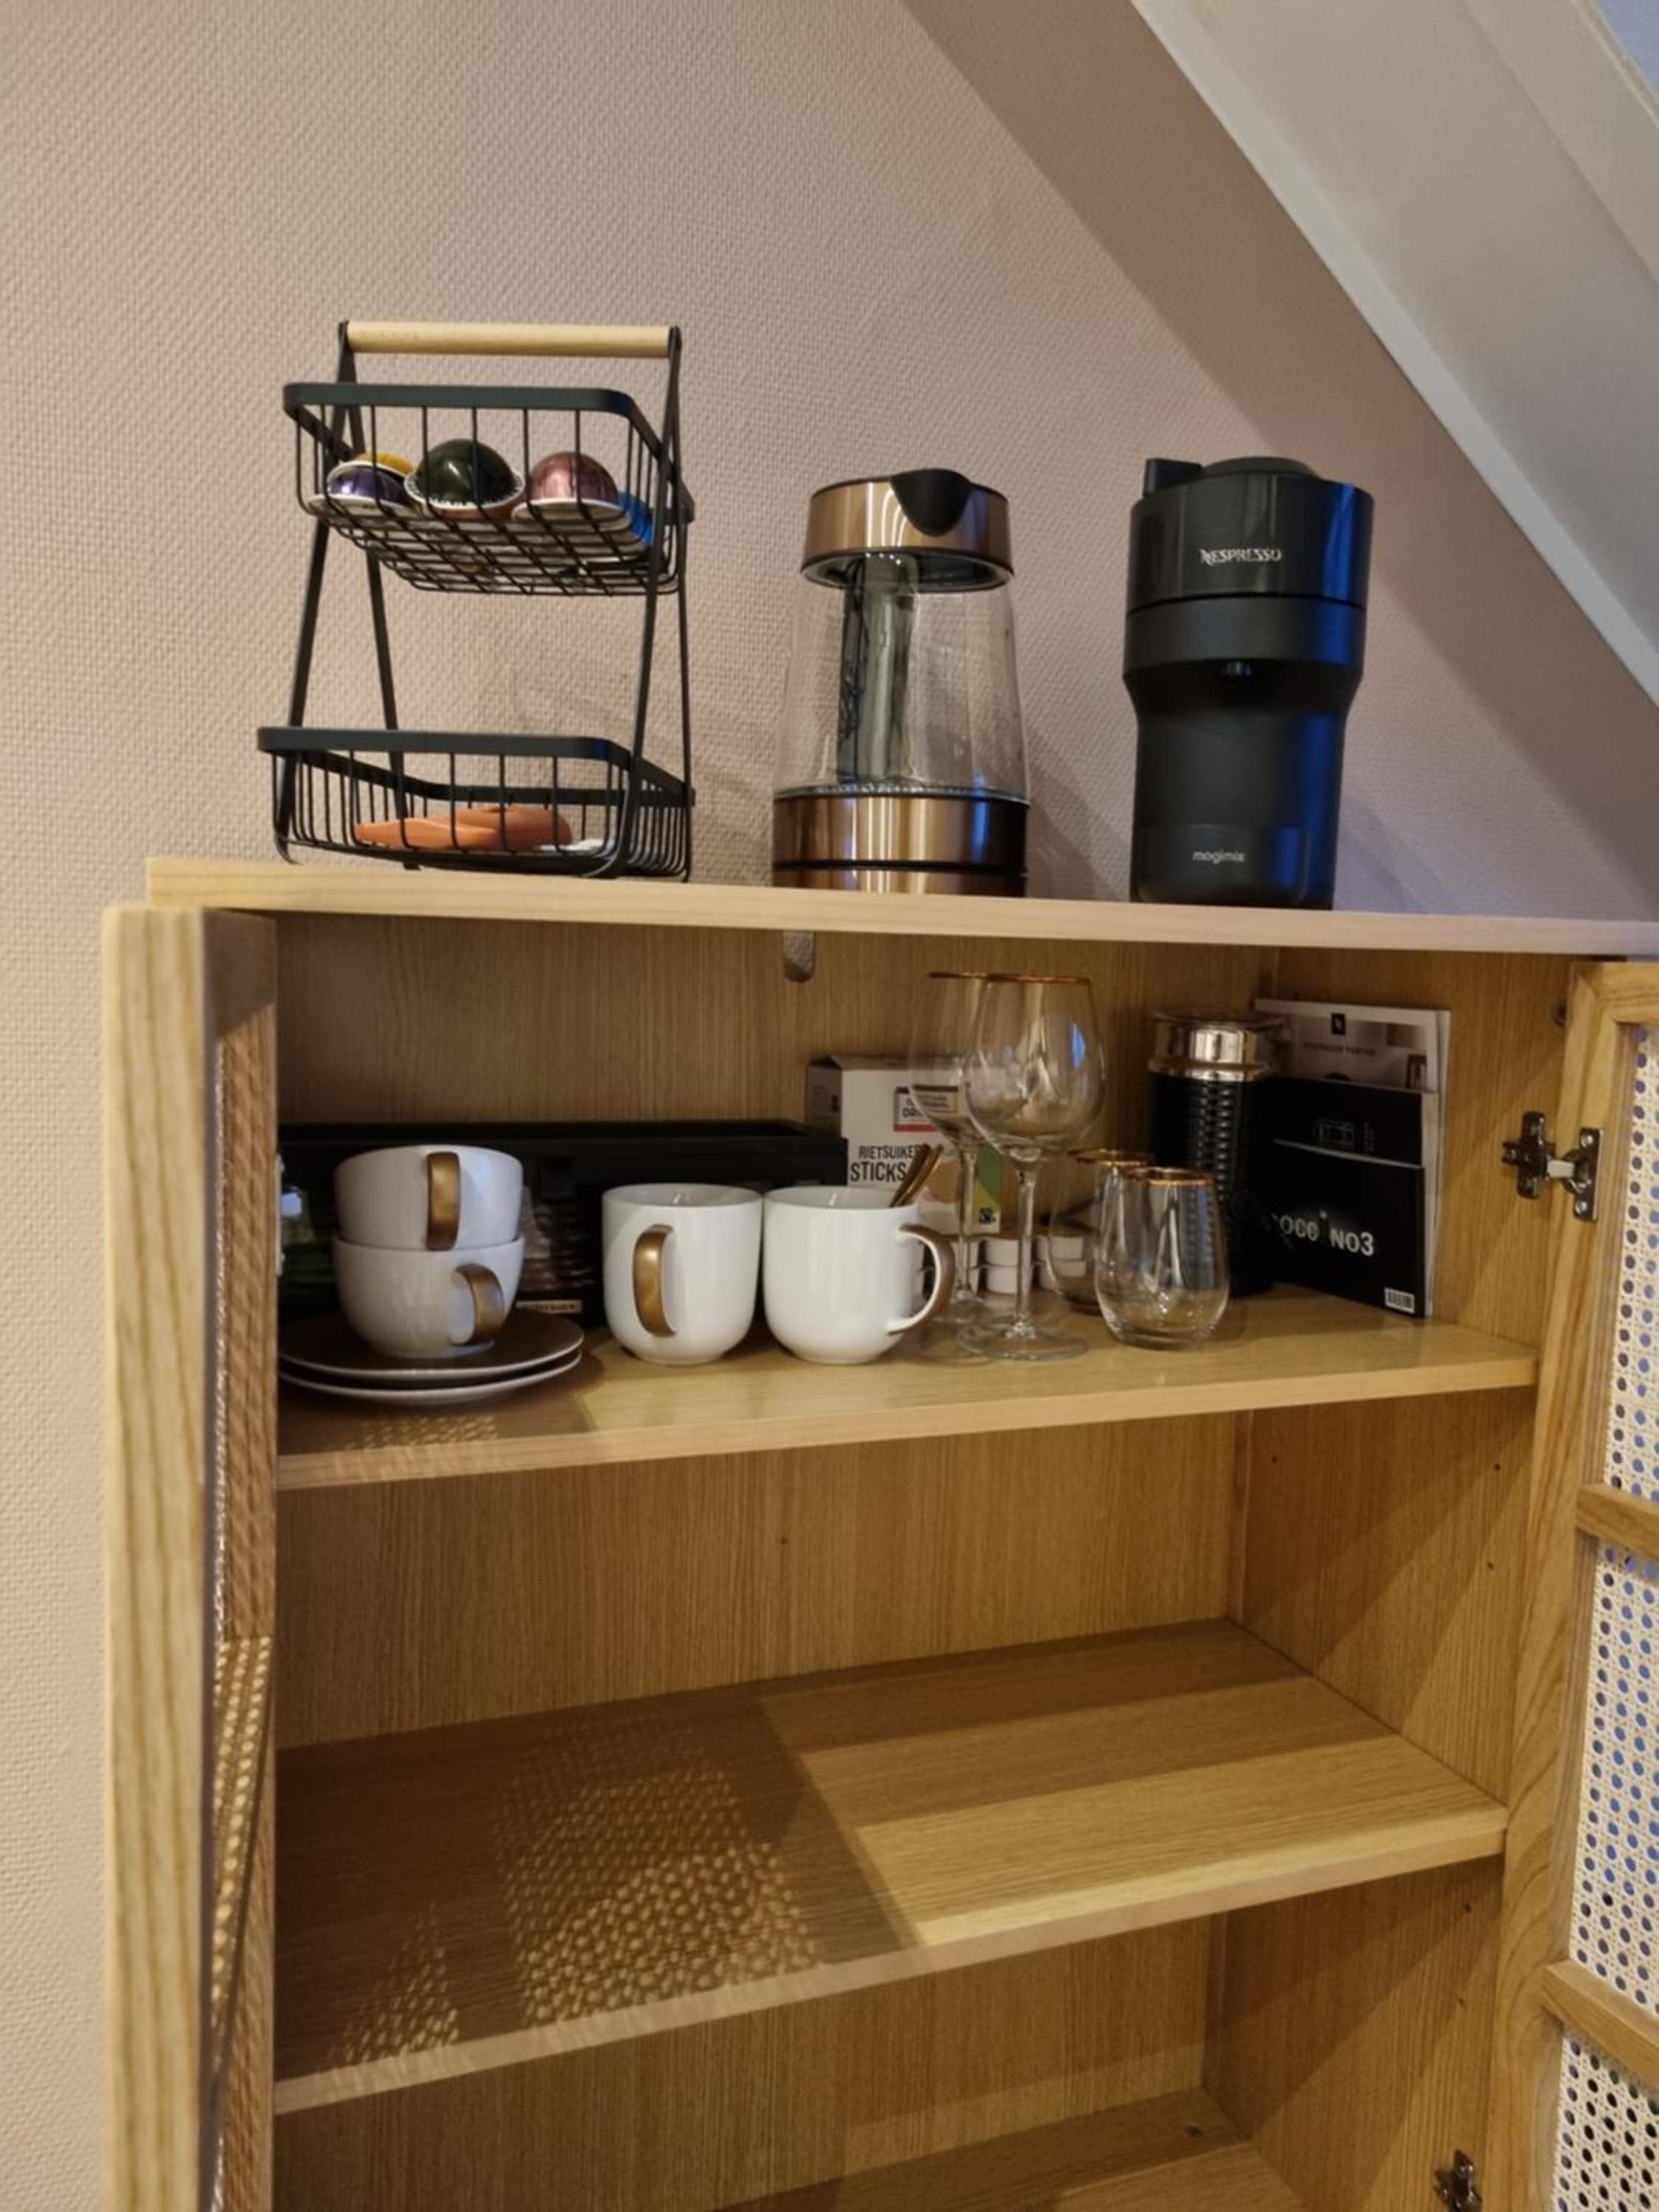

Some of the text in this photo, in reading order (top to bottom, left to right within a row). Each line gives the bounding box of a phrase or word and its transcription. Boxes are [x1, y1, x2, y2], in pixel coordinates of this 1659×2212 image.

[1199, 549, 1282, 566] NESPRESSO
[1192, 849, 1245, 864] magimix
[850, 1161, 908, 1182] STICKS
